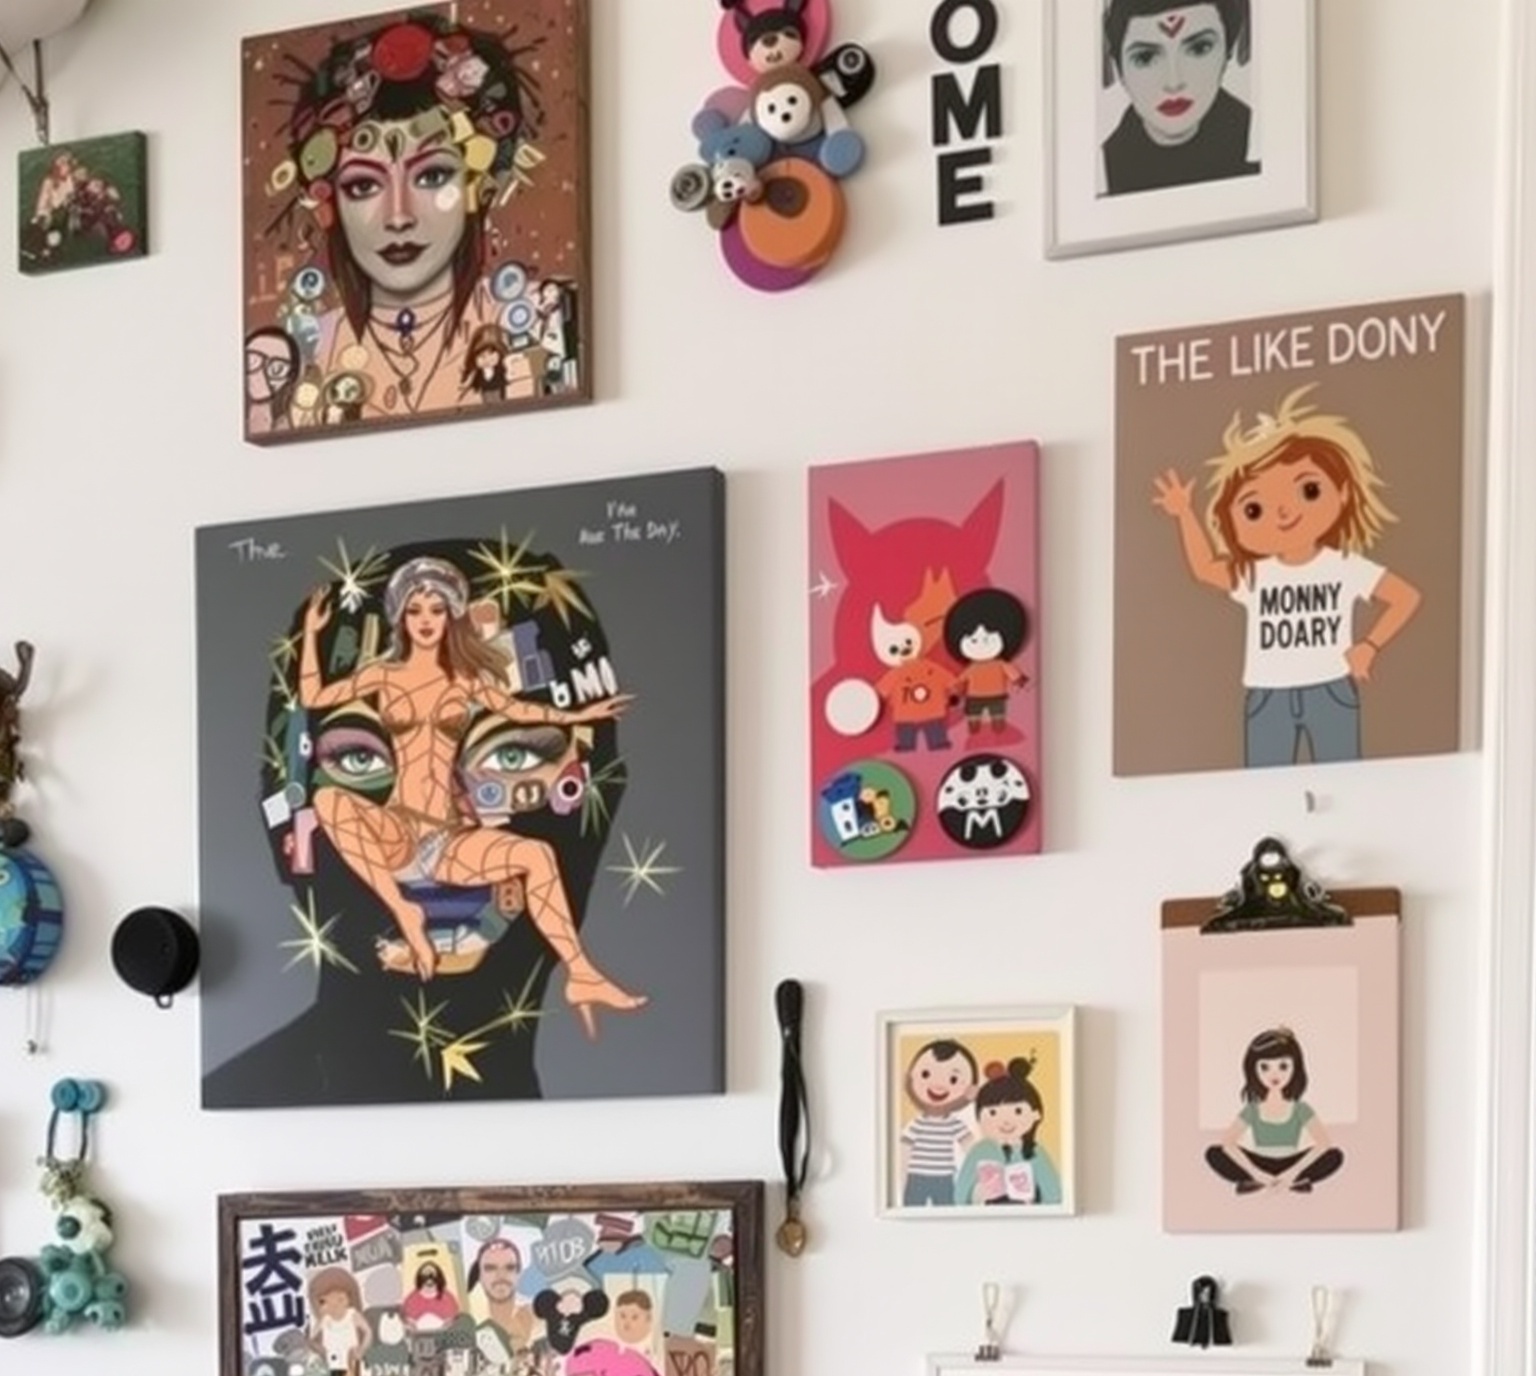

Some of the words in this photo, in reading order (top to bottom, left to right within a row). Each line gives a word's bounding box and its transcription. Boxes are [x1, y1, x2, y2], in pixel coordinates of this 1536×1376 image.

[1131, 339, 1214, 385] THE
[1230, 326, 1314, 376] LIKE
[1328, 311, 1446, 365] DONY
[1260, 581, 1342, 615] MONNY
[1260, 616, 1341, 650] DOARY
[964, 808, 1003, 840] M
